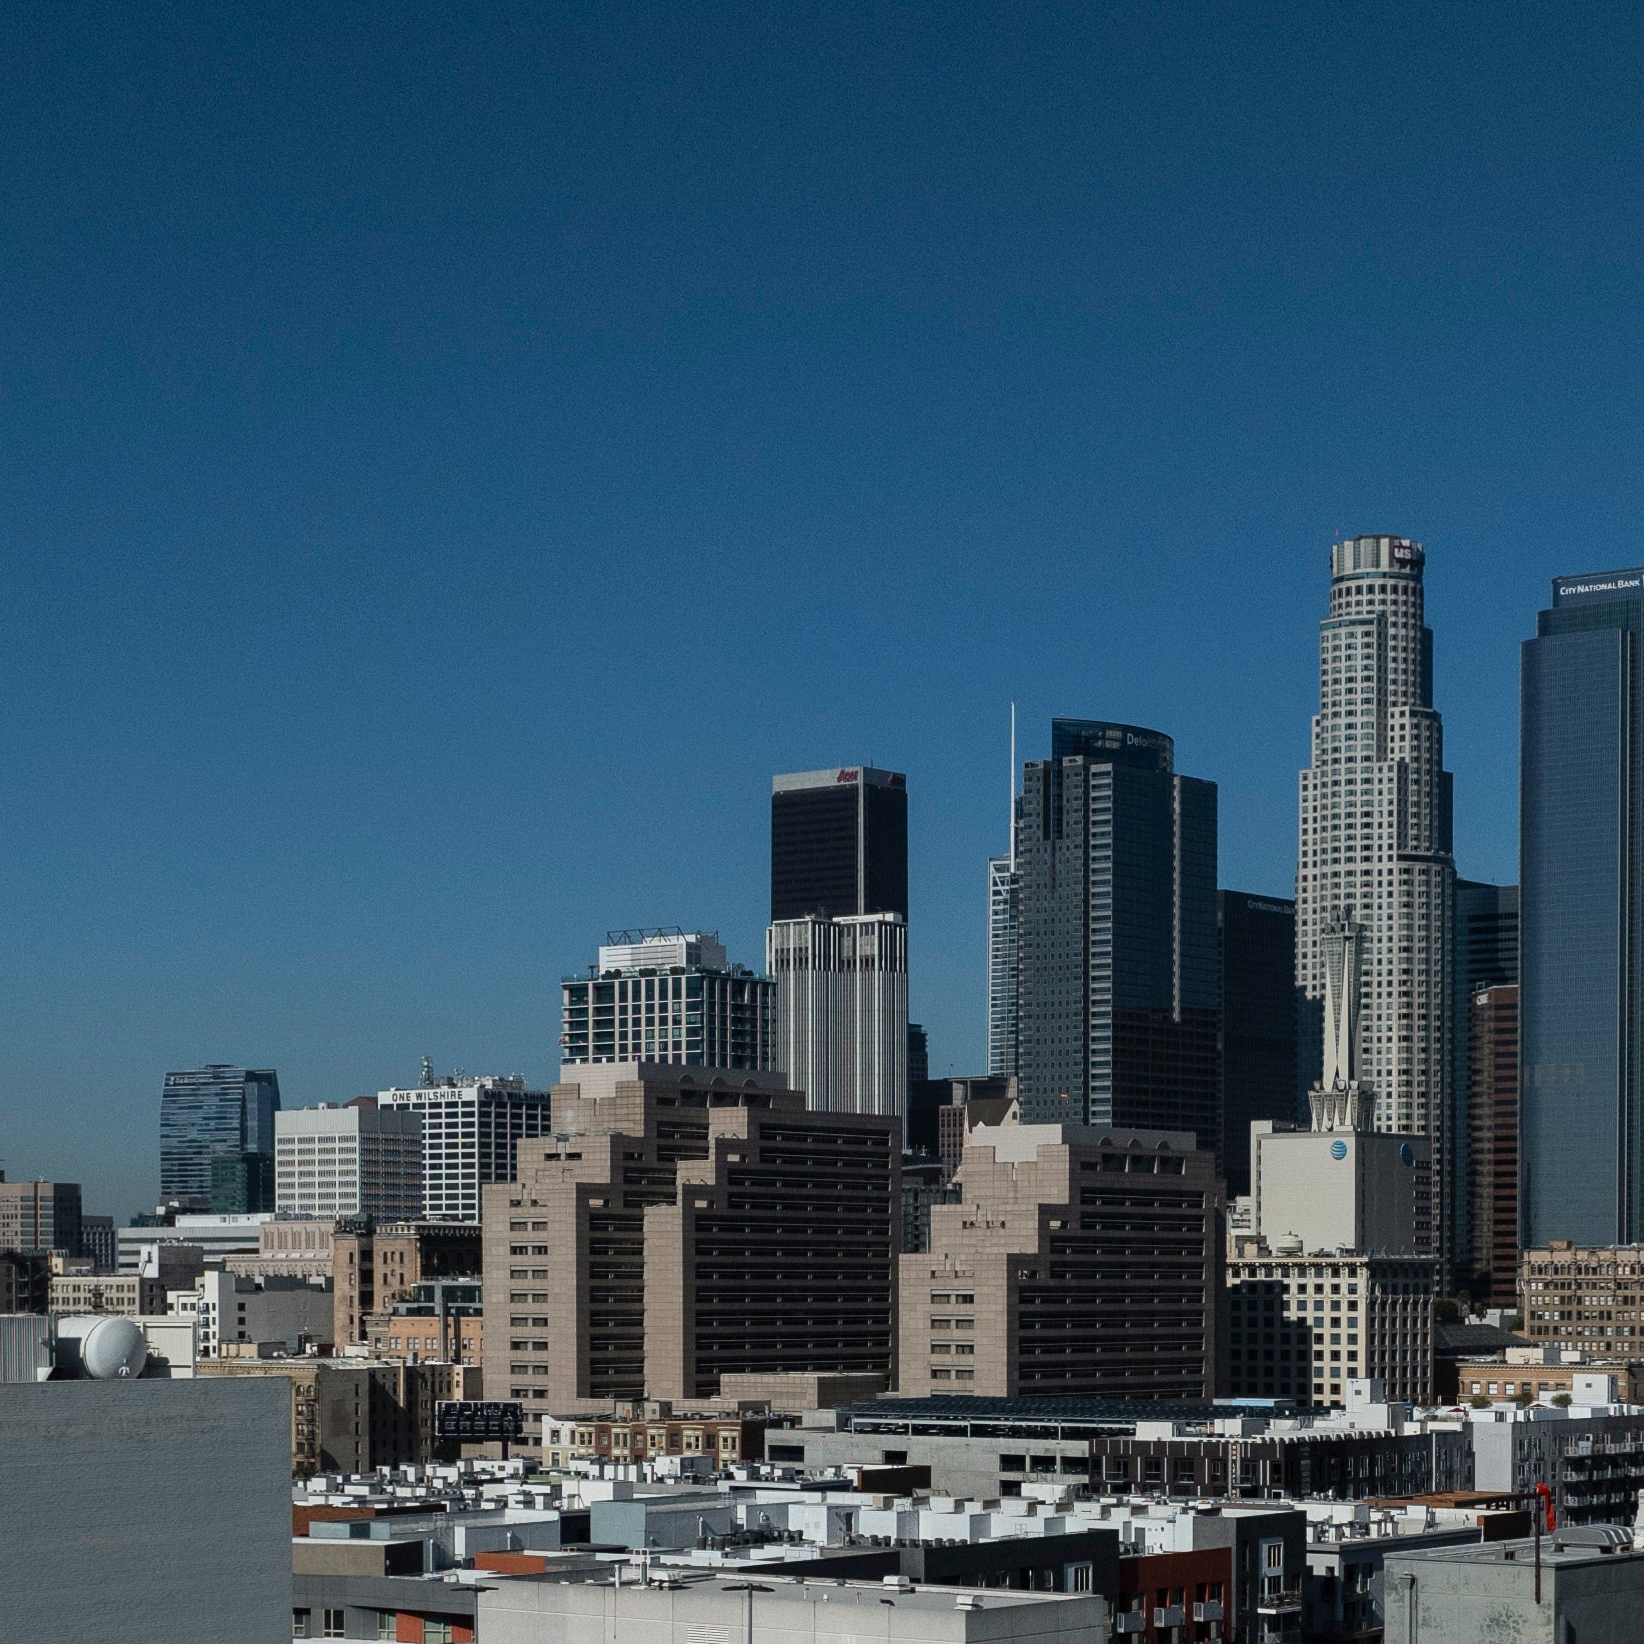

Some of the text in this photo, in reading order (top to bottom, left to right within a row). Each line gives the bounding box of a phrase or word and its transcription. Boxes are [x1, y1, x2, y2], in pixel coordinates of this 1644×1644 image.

[1617, 579, 1640, 589] BANK
[391, 1090, 463, 1102] ONE WILSHIRE
[483, 1090, 504, 1100] ONE
